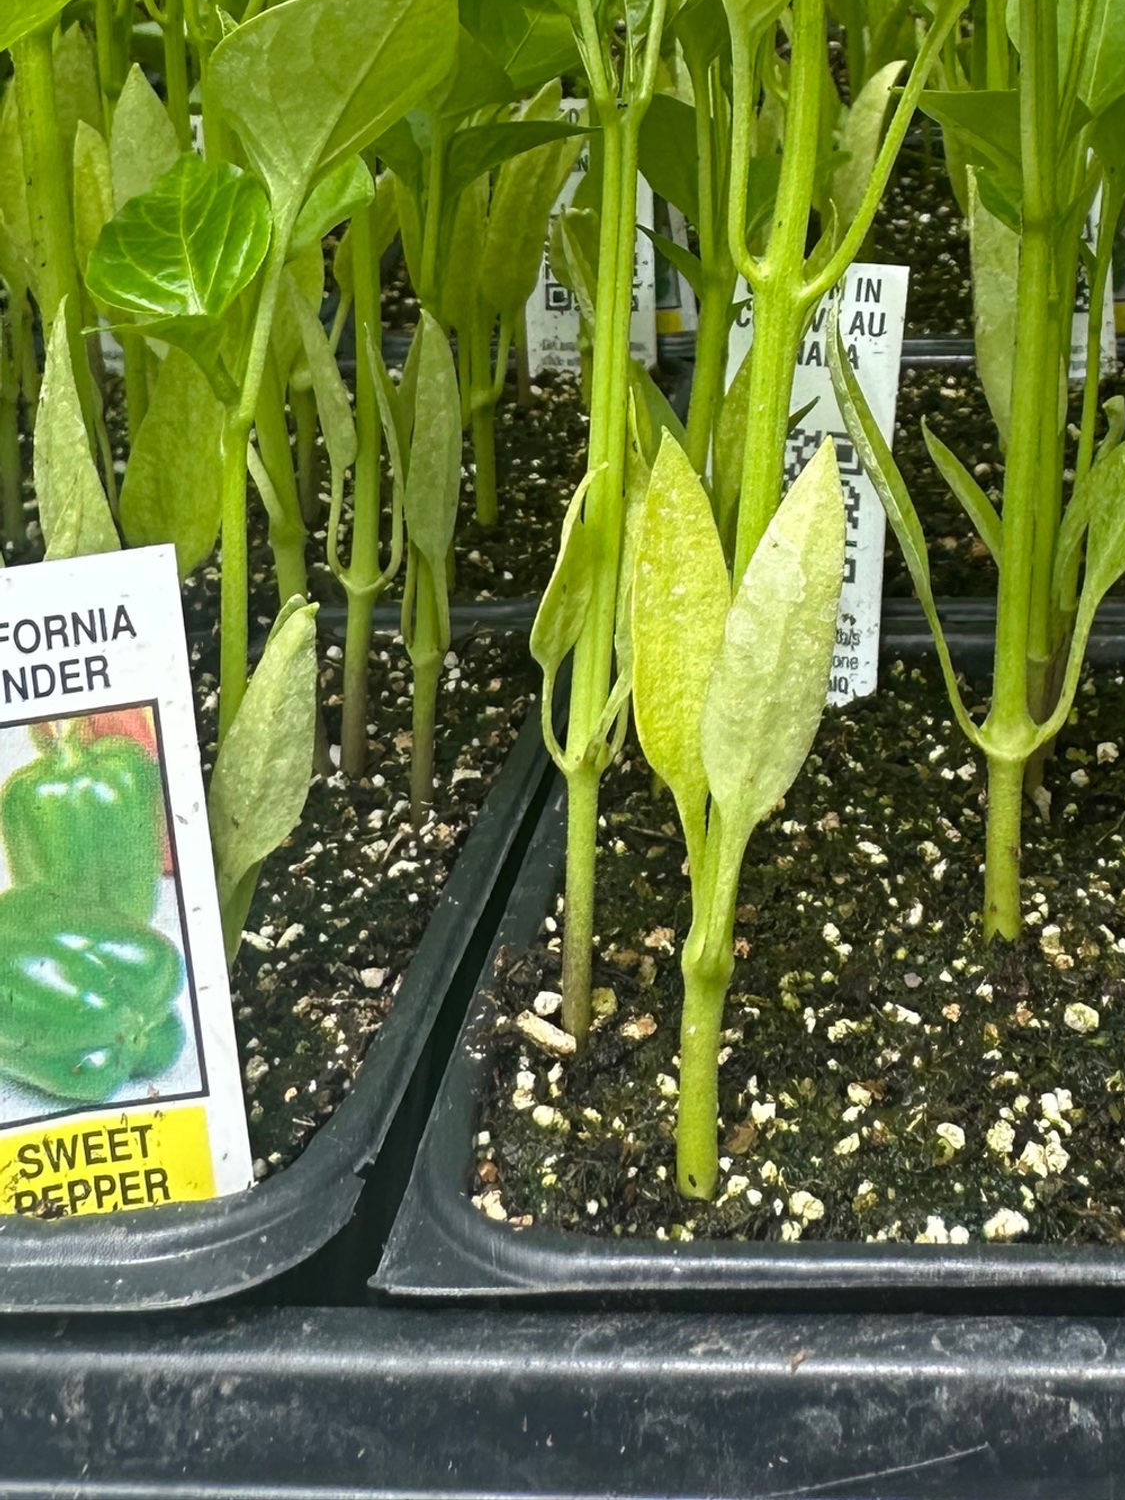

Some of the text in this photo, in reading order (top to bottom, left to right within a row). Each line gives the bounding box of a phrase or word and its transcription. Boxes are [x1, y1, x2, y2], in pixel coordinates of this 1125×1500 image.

[855, 277, 882, 303] IN
[849, 311, 886, 337] AU
[17, 1124, 153, 1180] SWEET
[14, 1167, 171, 1214] PEPPER
